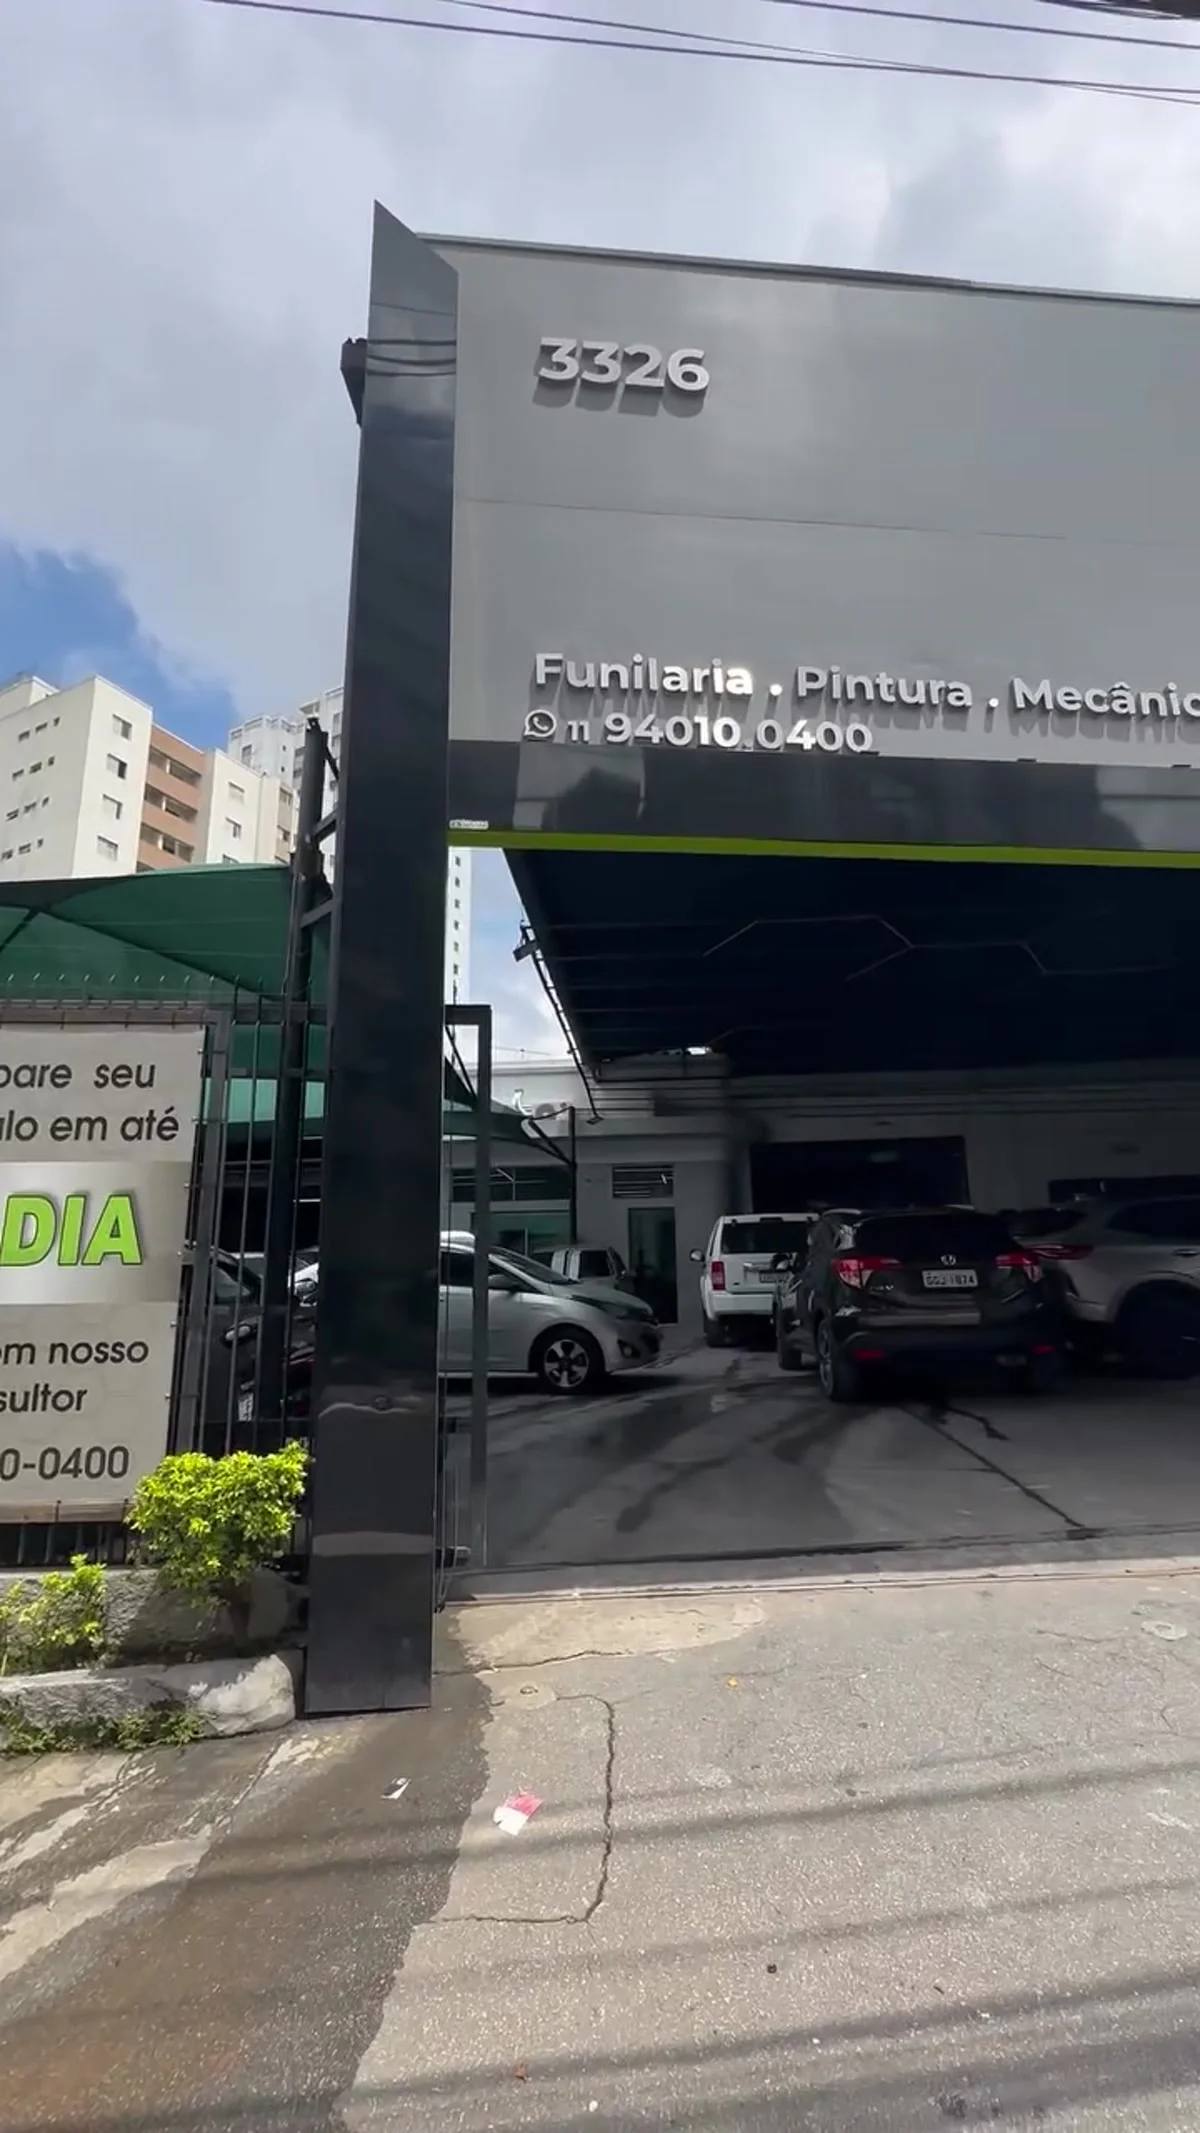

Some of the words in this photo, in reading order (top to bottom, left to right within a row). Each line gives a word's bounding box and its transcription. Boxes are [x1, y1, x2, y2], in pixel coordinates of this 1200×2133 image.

[538, 337, 710, 391] 3326
[535, 653, 753, 695] Funilaria
[797, 666, 973, 707] Pintura
[1012, 677, 1200, 718] Mecânic
[567, 720, 590, 742] 11
[93, 1064, 156, 1088] seu
[0, 1109, 38, 1141] lo
[50, 1116, 107, 1141] em
[120, 1106, 179, 1141] até
[0, 1194, 143, 1266] DIA
[0, 1343, 36, 1364] m
[49, 1341, 149, 1363] nosso
[0, 1446, 130, 1481] 0-0400
